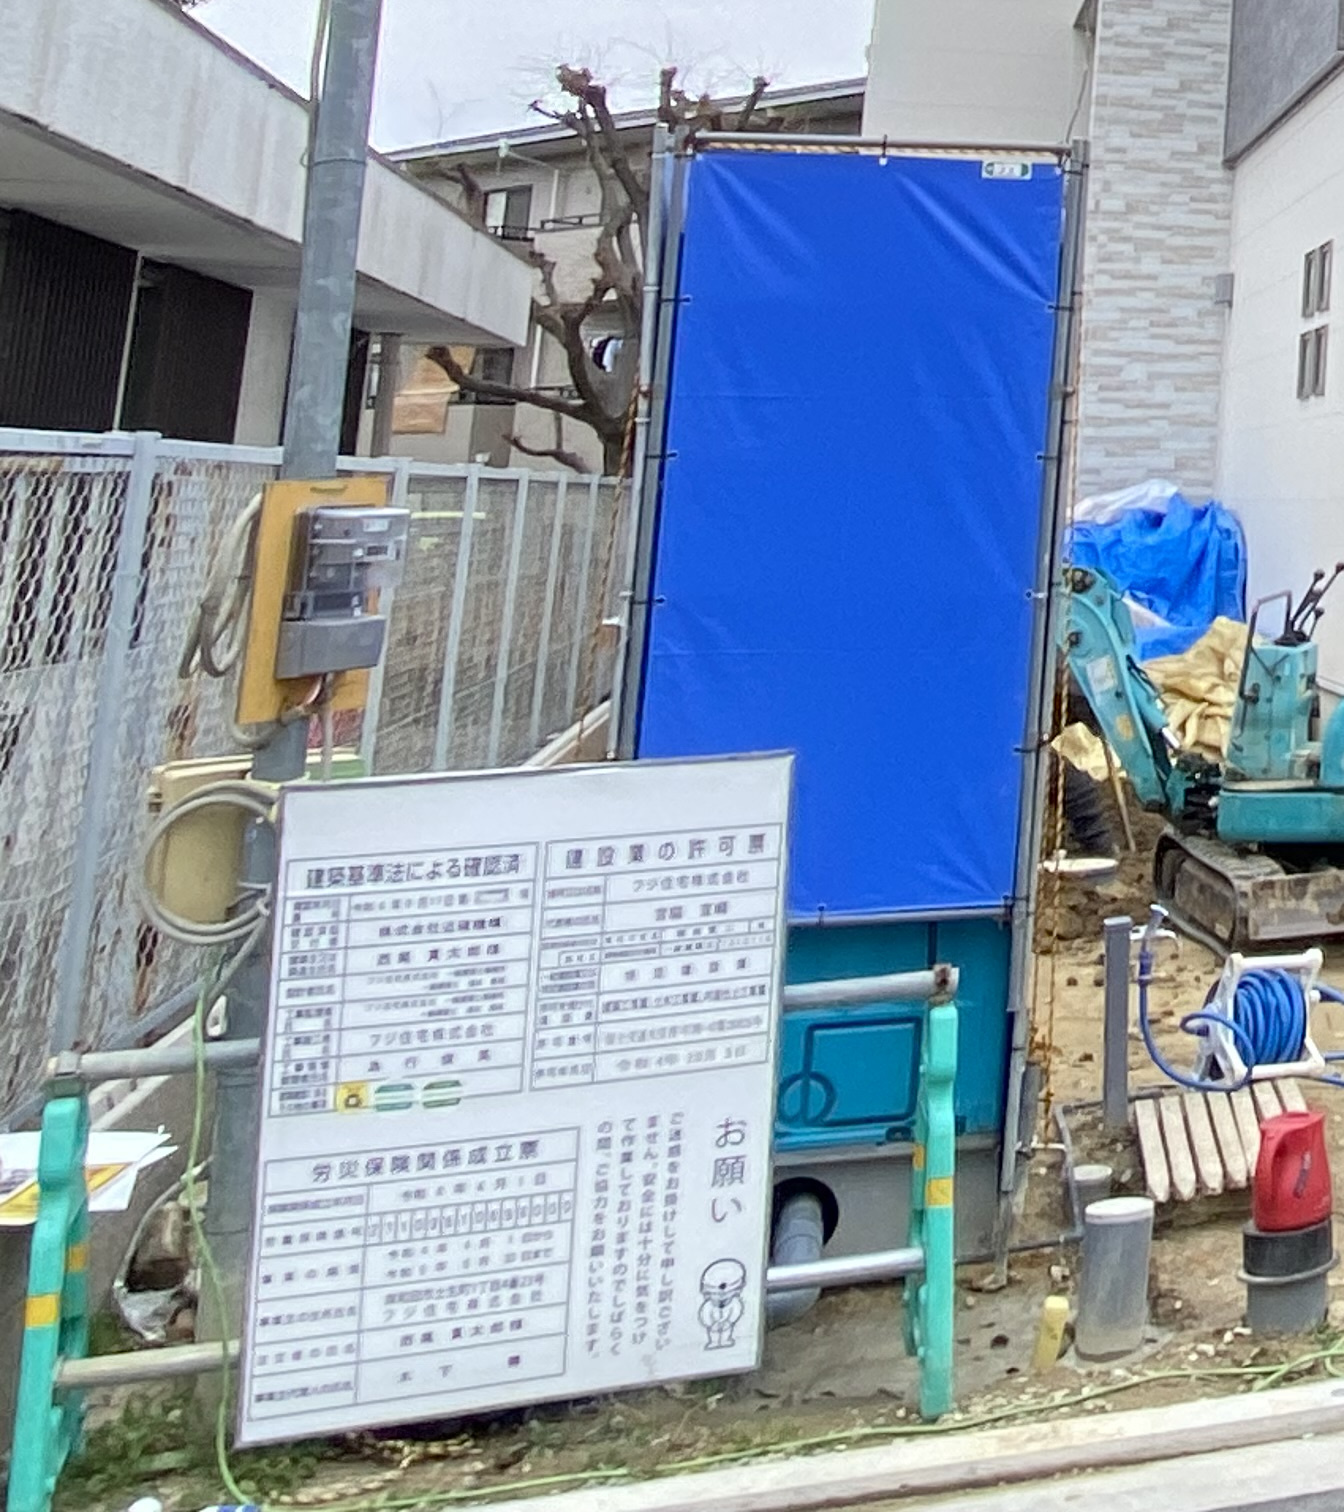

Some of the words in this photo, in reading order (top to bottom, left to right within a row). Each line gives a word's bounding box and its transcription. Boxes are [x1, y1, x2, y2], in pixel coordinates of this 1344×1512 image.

[306, 854, 520, 888] 建築基準法による確認済
[312, 1139, 540, 1183] 労災保険関係成立票
[711, 1116, 748, 1224] お願い
